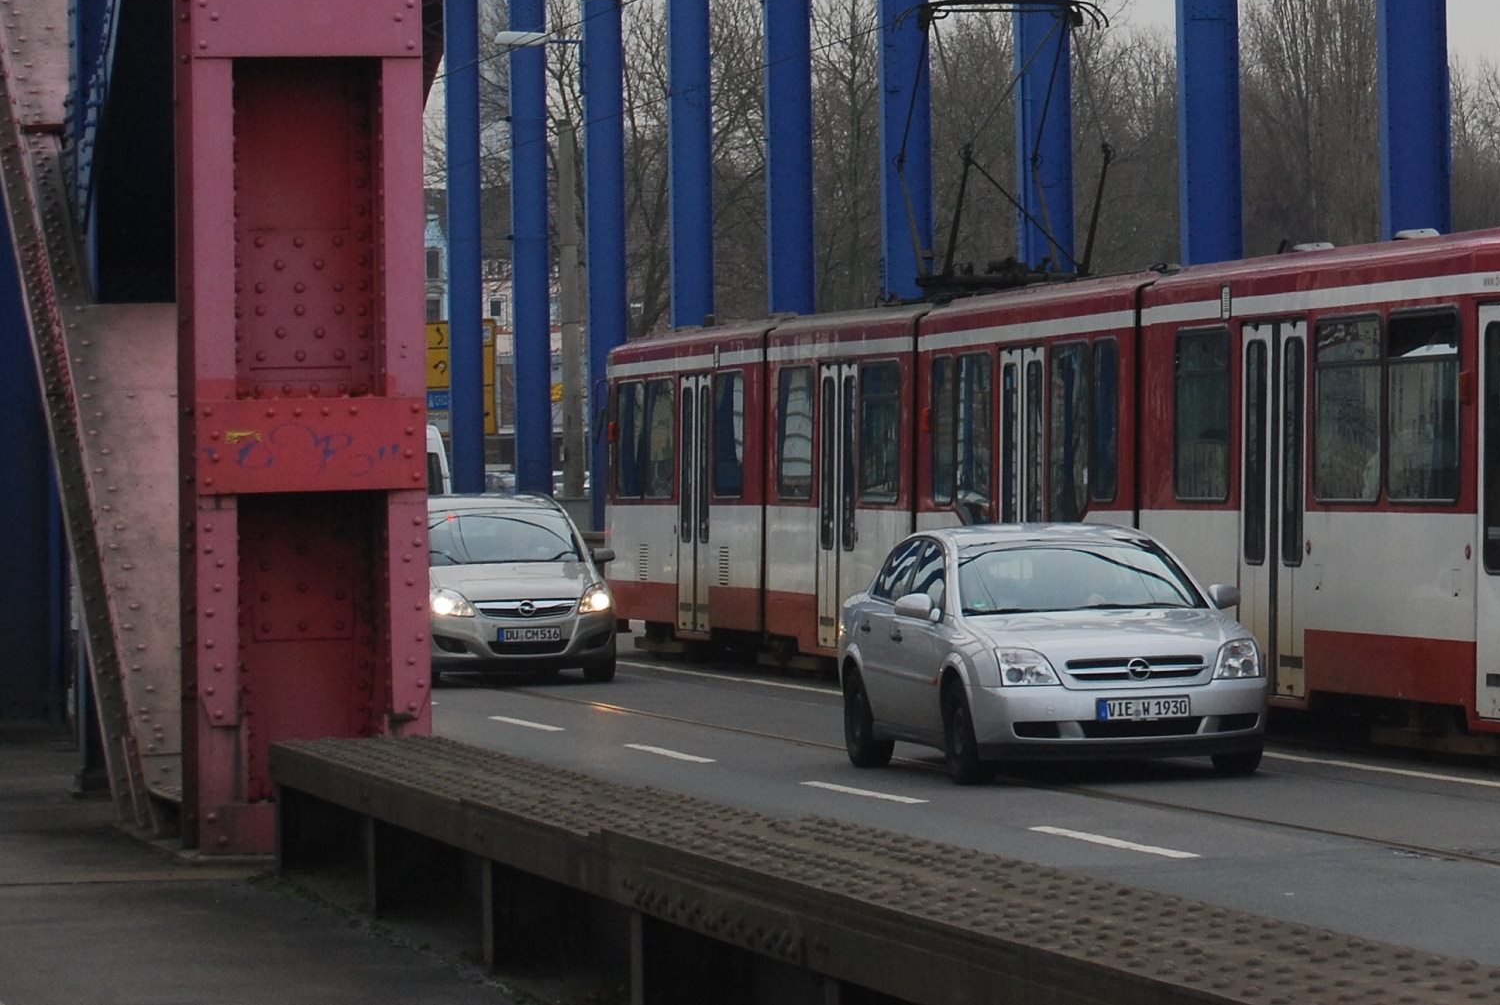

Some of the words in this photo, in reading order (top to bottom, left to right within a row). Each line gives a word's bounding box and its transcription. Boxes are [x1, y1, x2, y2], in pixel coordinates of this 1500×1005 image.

[505, 629, 519, 641] DU
[1108, 701, 1133, 717] VIE
[1142, 701, 1150, 716] W
[1154, 699, 1187, 716] 1930
